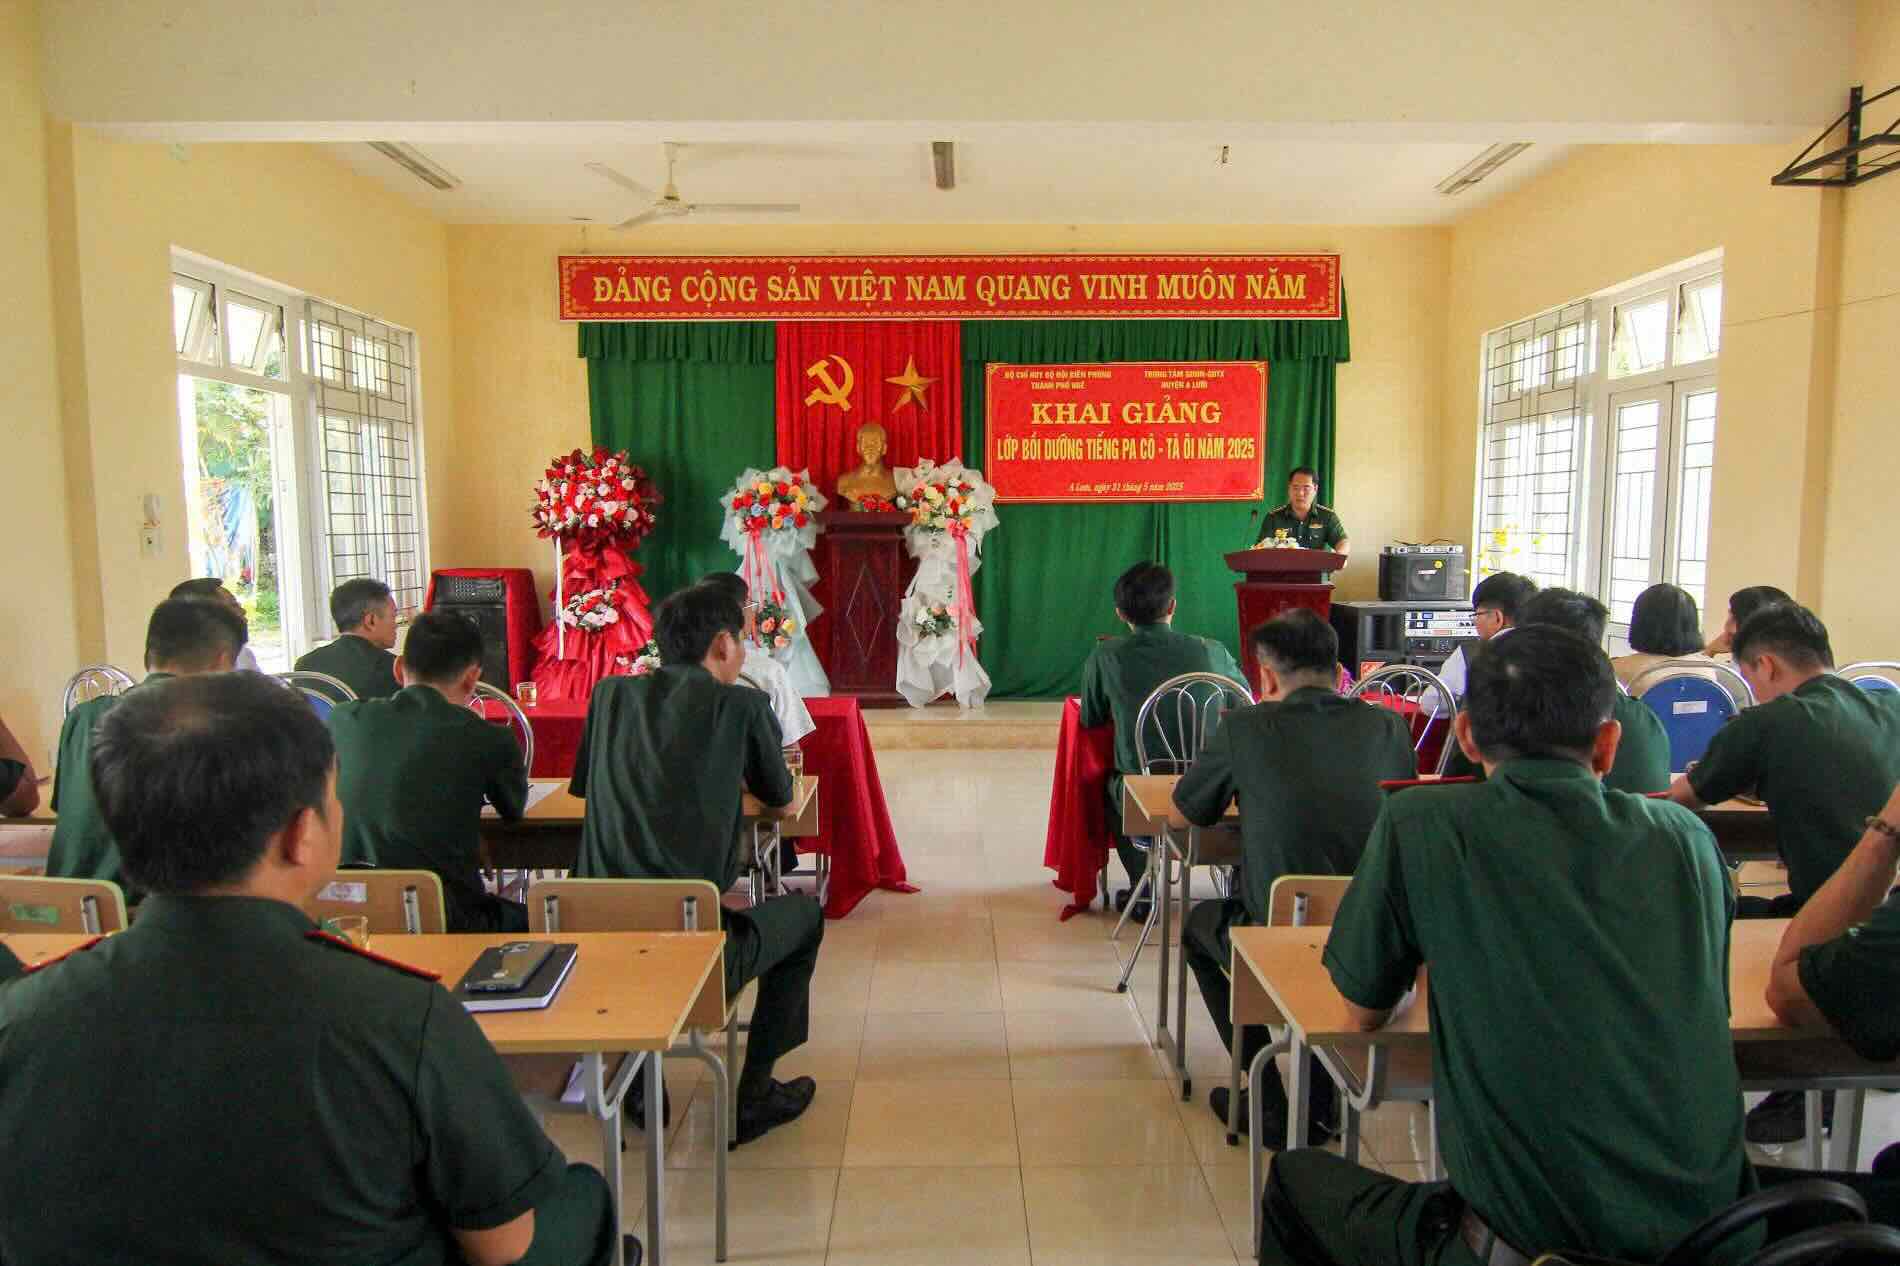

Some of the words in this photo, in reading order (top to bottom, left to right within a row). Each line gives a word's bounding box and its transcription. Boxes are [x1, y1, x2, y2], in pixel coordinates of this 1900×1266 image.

[593, 266, 672, 302] ĐẢNG
[680, 269, 757, 308] CỘNG
[767, 265, 822, 302] SẢN
[829, 268, 897, 307] VIỆT
[905, 275, 967, 302] NAM
[975, 275, 1072, 306] QUANG
[1079, 275, 1148, 300] VINH
[1156, 267, 1236, 300] MUÔN
[1245, 267, 1307, 300] NĂM
[1031, 403, 1112, 425] KHAI
[1122, 395, 1223, 425] GIẢNG
[997, 433, 1019, 460] LỚP
[1086, 431, 1119, 460] TIẾNG
[1122, 438, 1137, 460] PA
[1140, 433, 1156, 460] CÔ
[1198, 433, 1225, 460] NĂM
[1227, 437, 1255, 460] 2025
